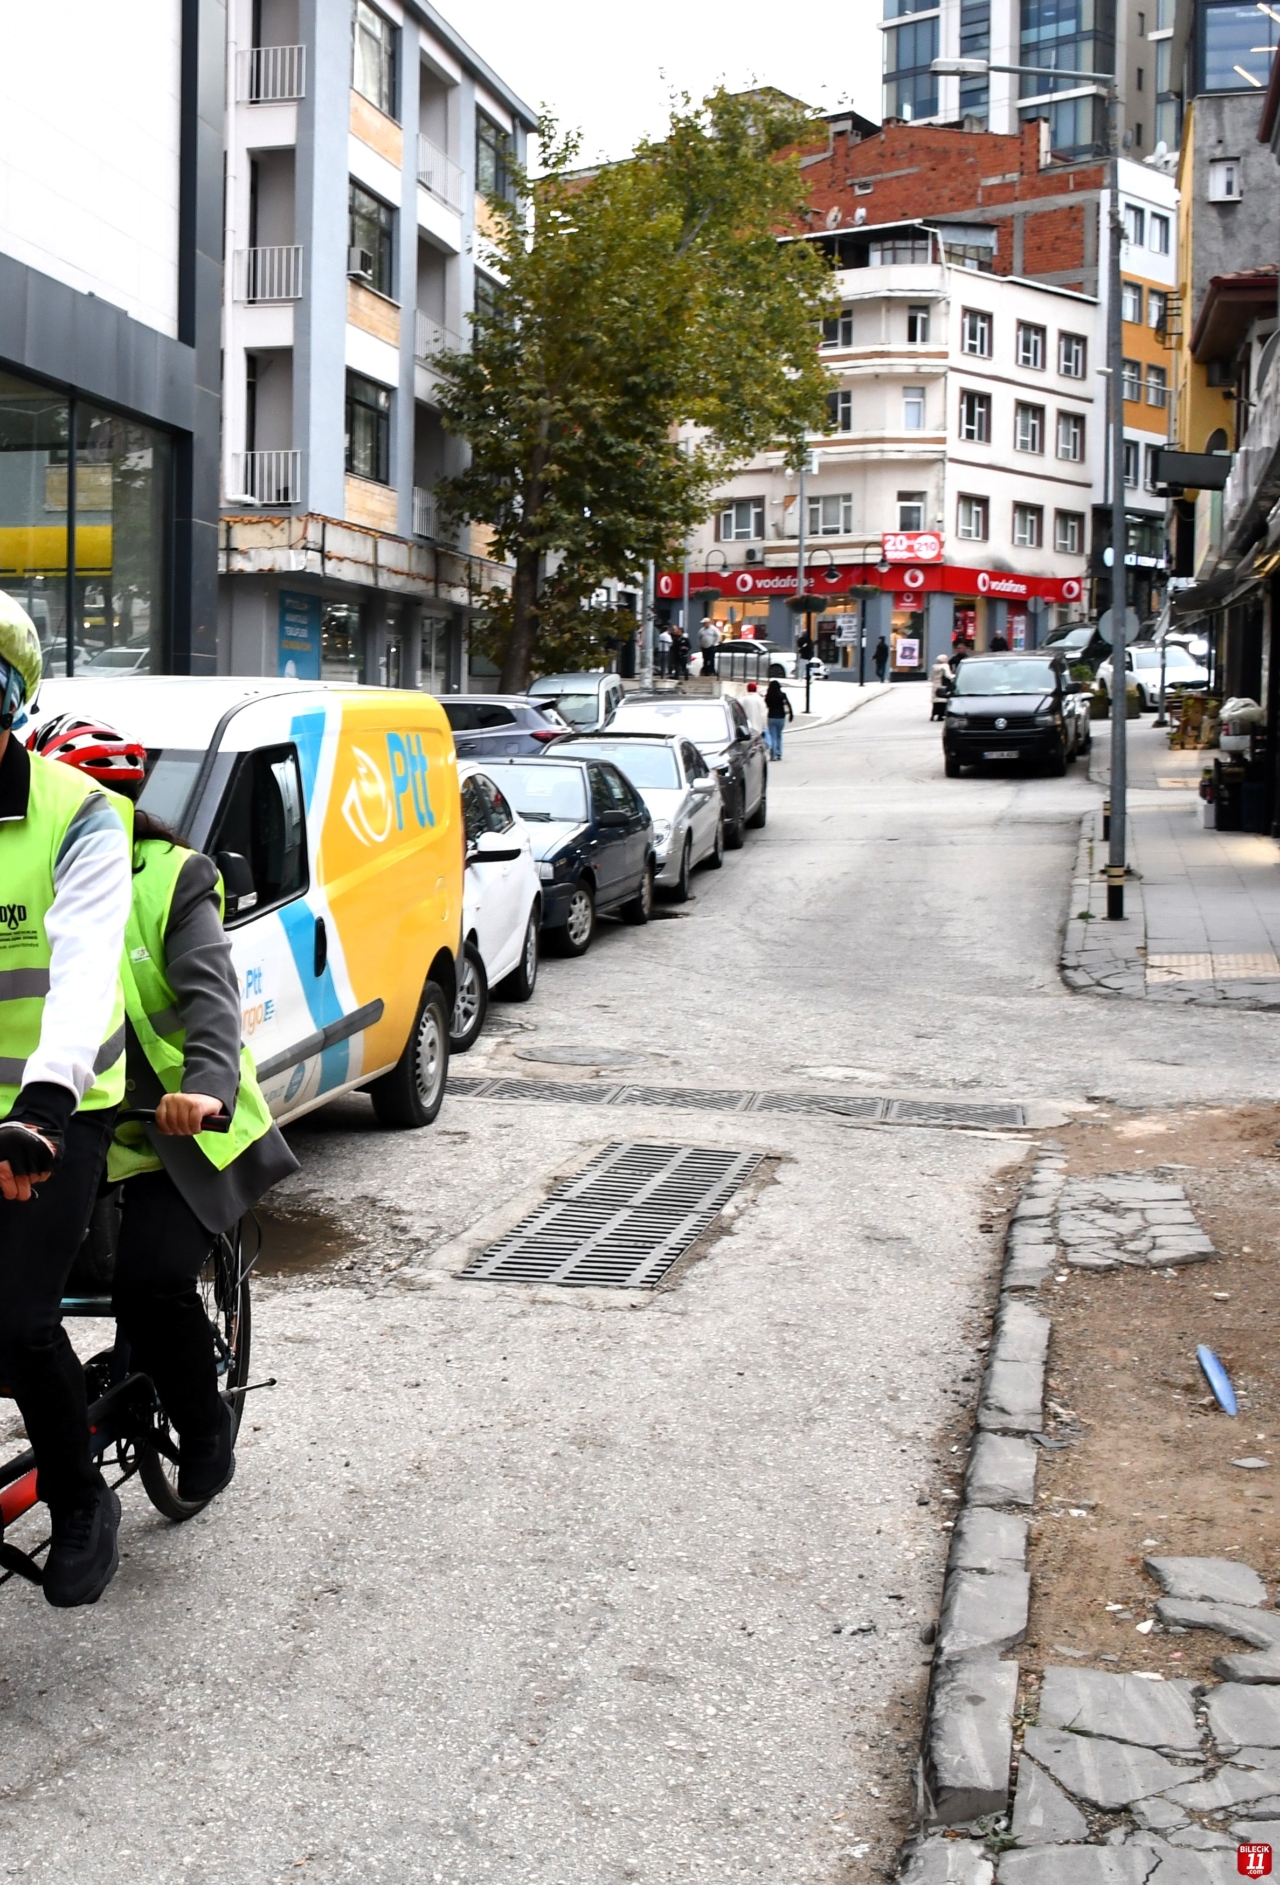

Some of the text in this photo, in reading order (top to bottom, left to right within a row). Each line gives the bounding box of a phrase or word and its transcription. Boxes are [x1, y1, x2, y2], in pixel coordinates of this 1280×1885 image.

[990, 579, 1027, 594] vodafone
[386, 732, 435, 831] Ptt
[245, 966, 263, 999] Ptt
